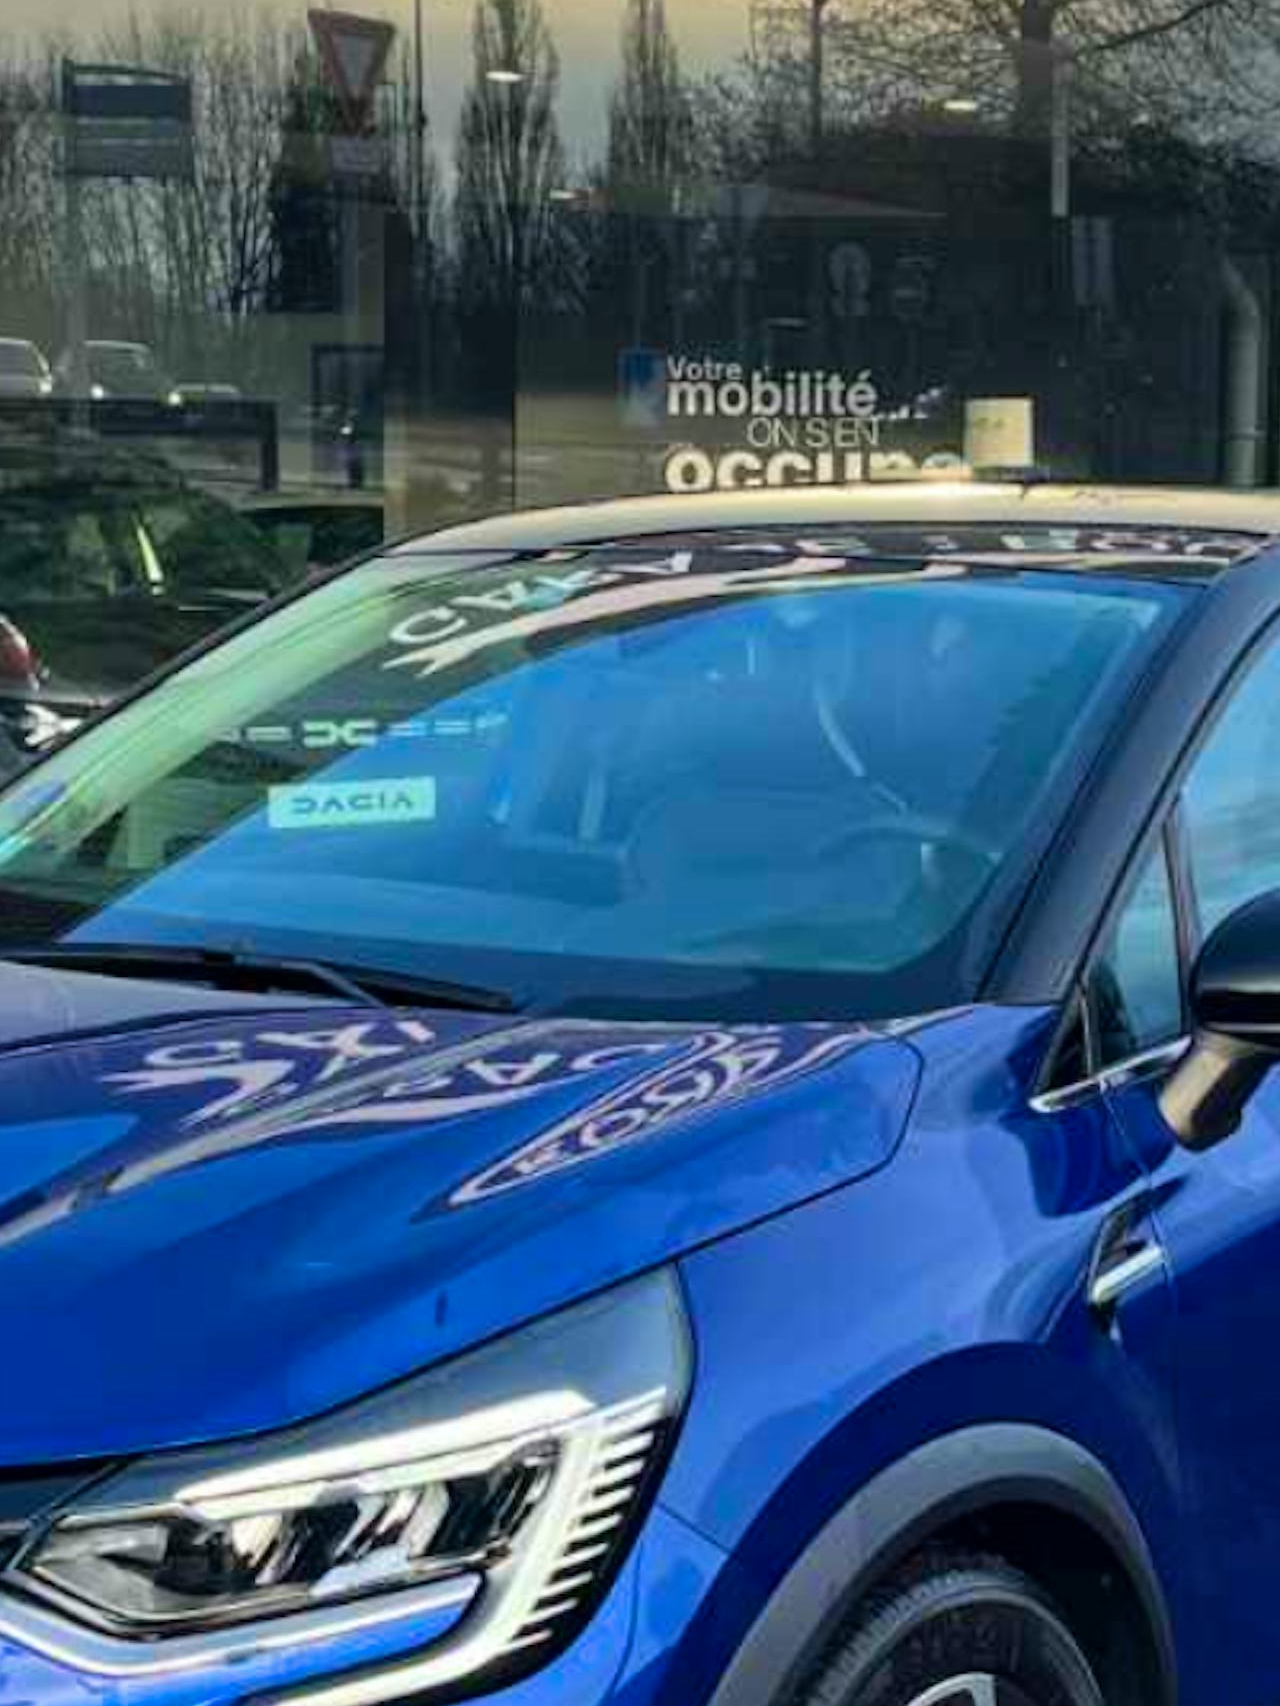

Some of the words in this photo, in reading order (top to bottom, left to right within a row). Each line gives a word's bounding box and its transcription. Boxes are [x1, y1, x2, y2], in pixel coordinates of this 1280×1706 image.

[667, 354, 743, 381] Votre
[667, 368, 878, 417] mobilité
[746, 415, 797, 448] ON
[290, 791, 414, 815] DACIA
